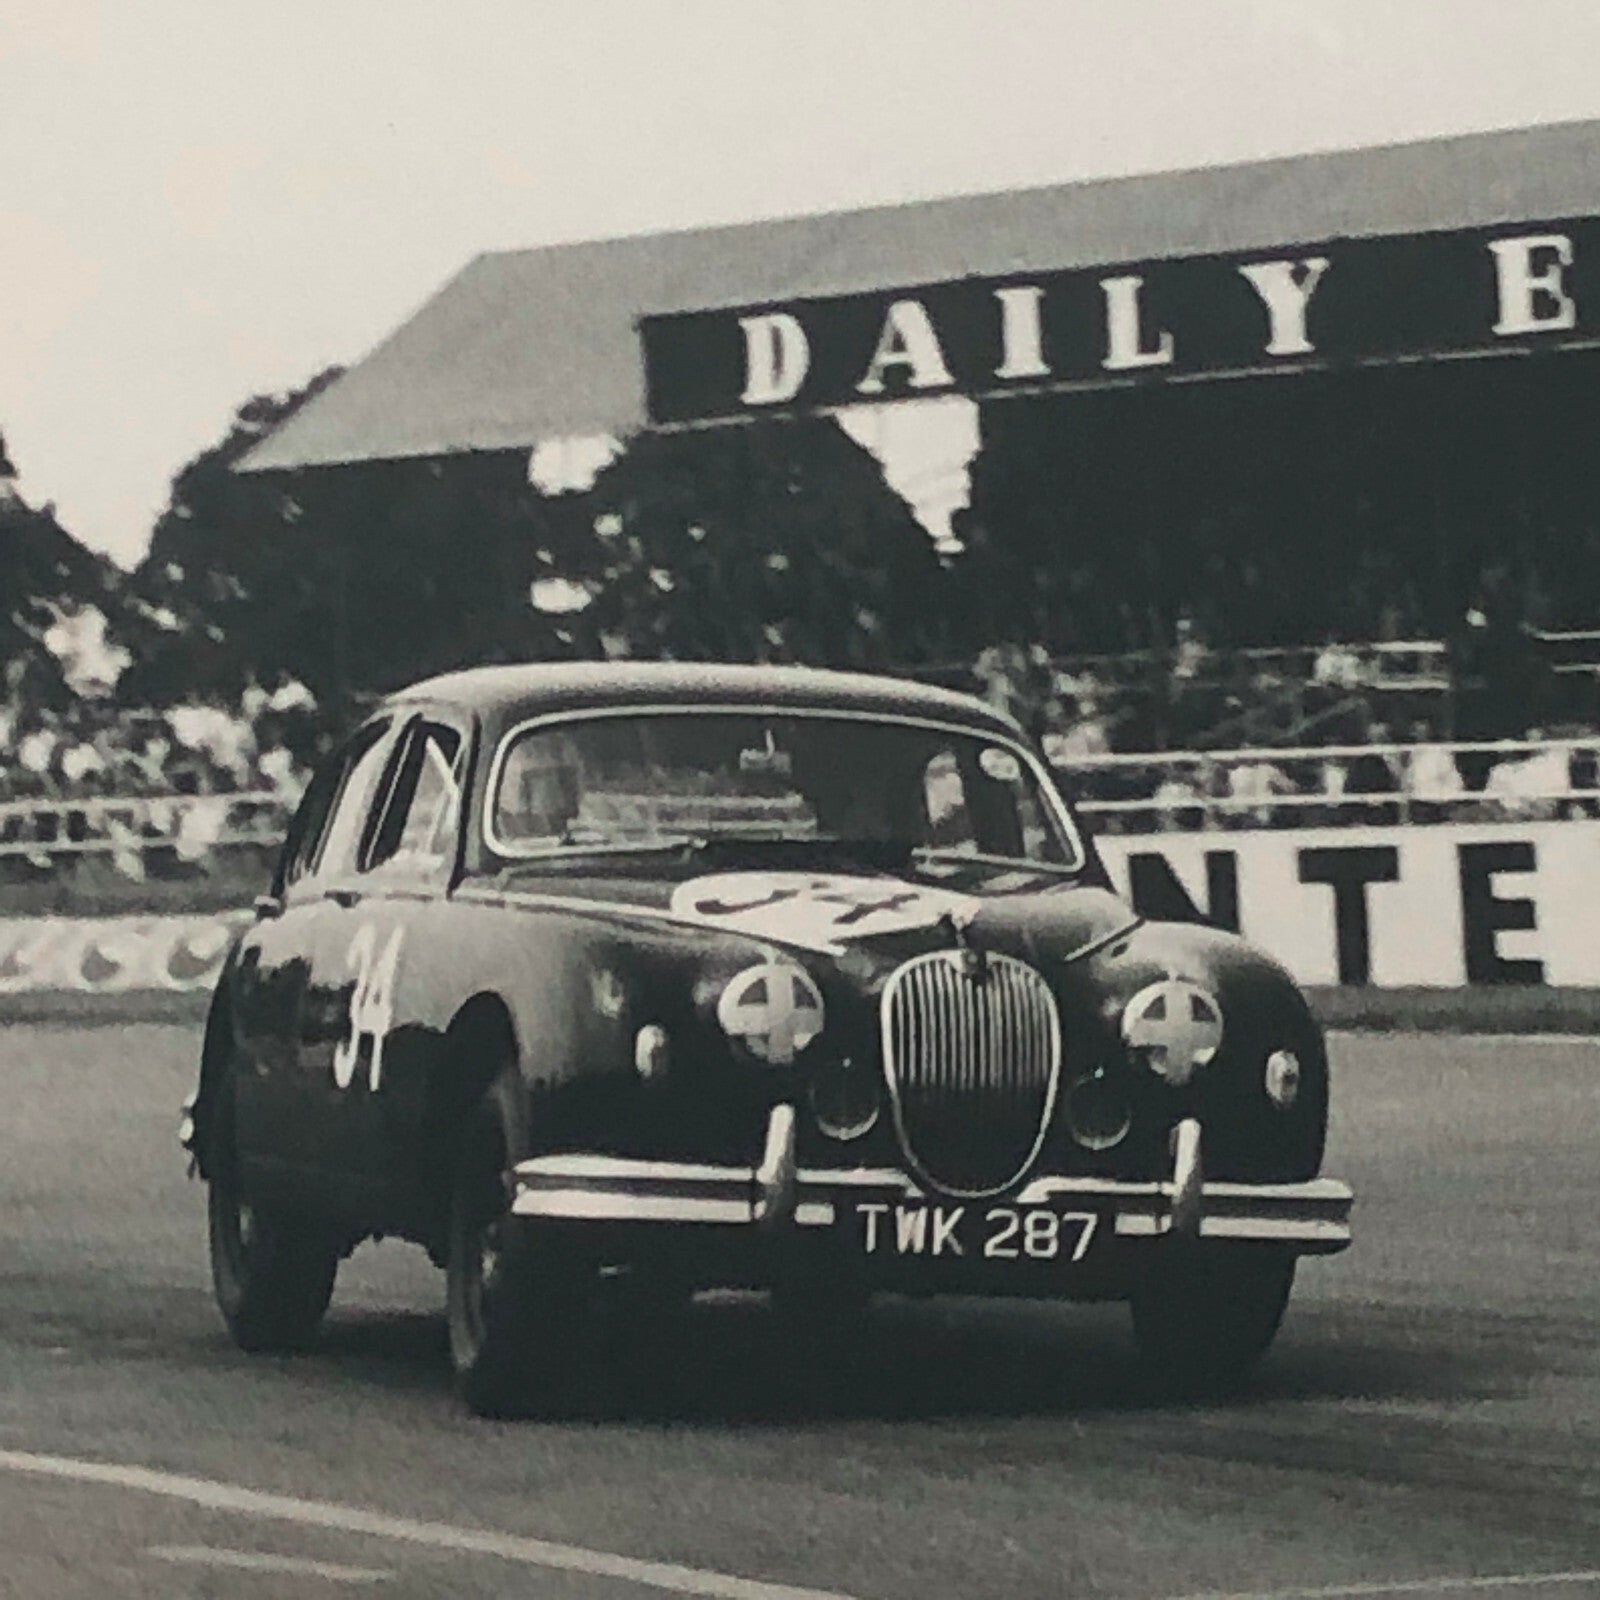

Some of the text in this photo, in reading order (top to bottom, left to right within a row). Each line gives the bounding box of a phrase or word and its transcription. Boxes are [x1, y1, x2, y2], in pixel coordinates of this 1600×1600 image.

[739, 257, 1330, 405] DAILY
[856, 1203, 1098, 1262] TWK 287
